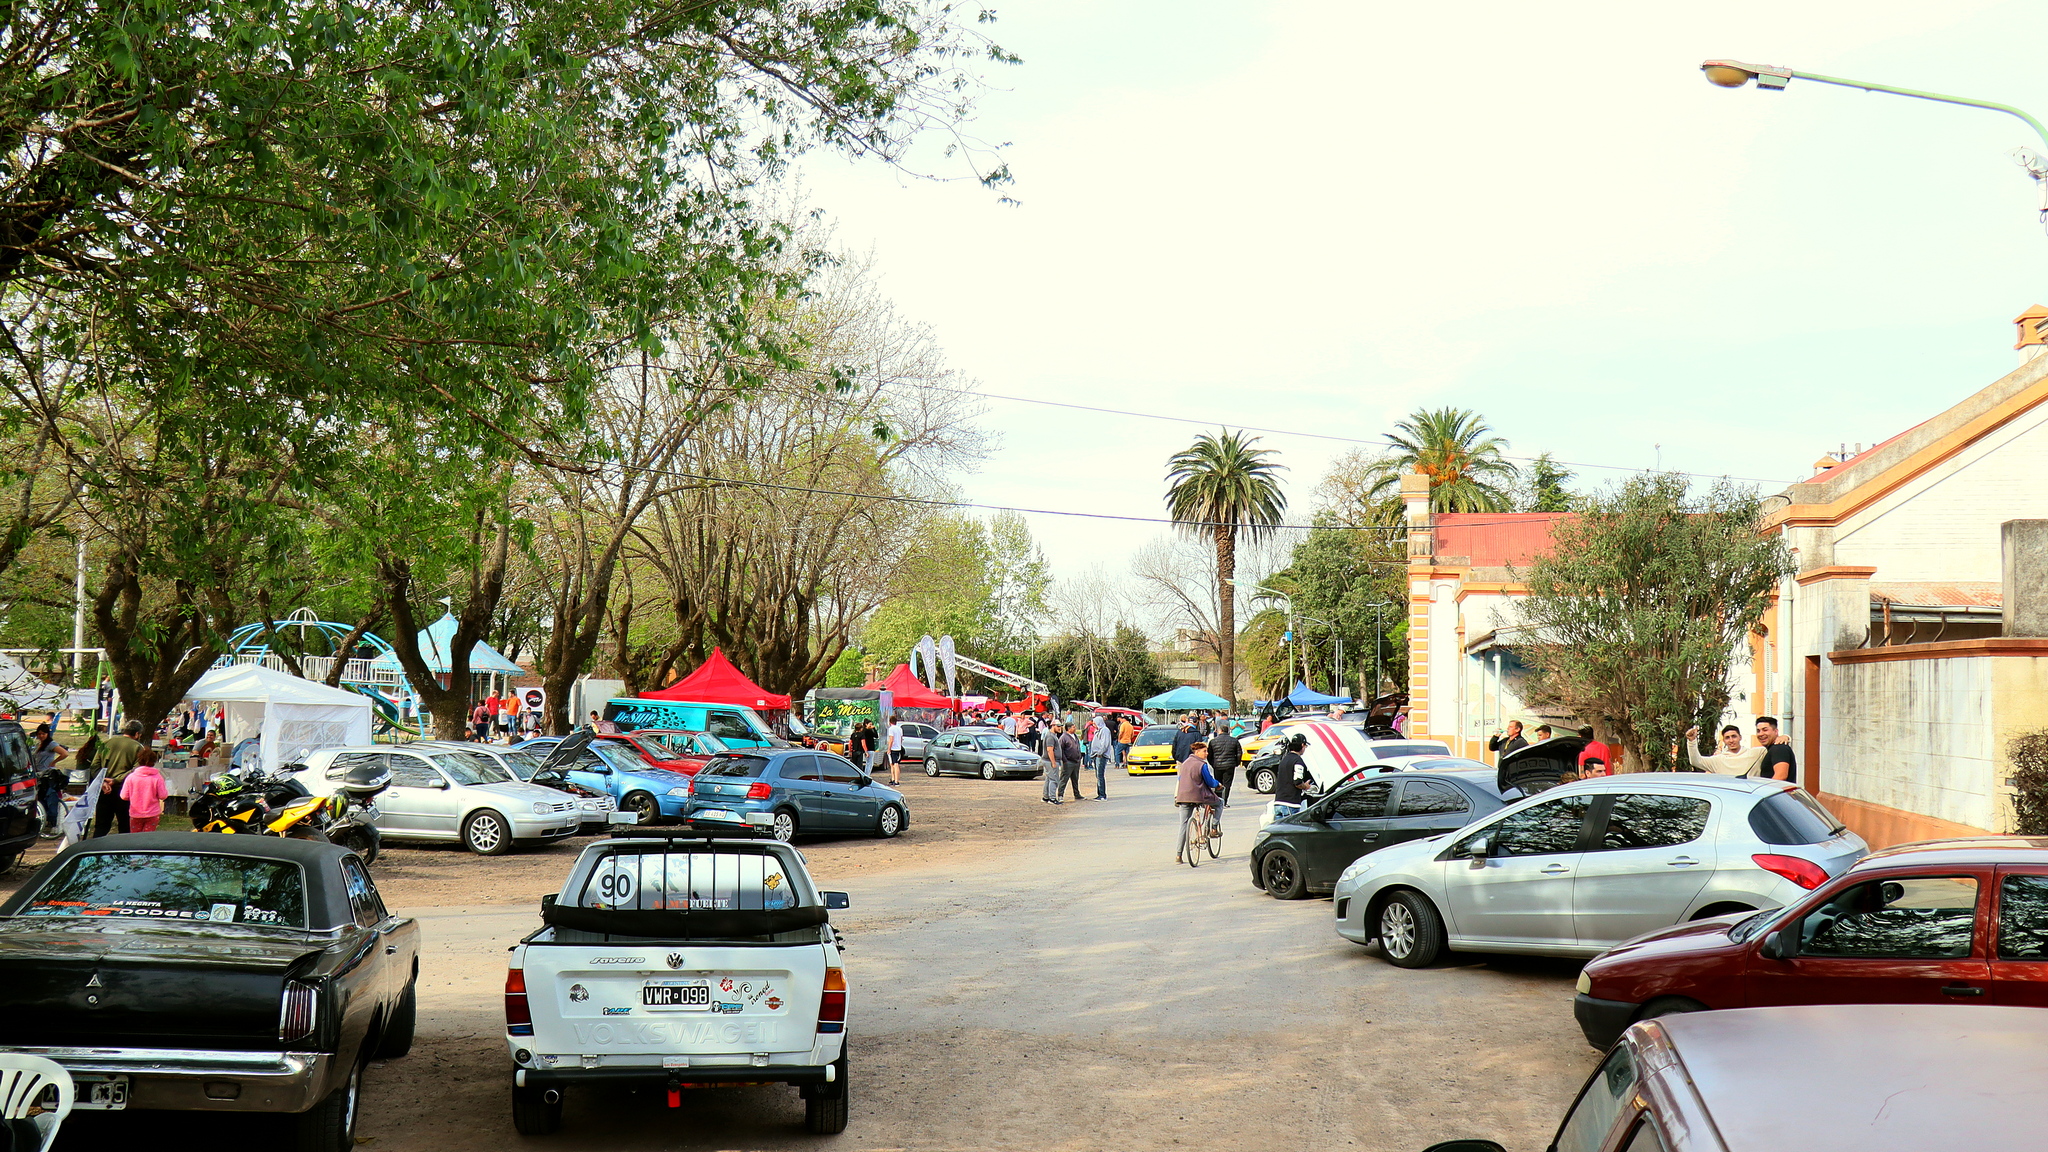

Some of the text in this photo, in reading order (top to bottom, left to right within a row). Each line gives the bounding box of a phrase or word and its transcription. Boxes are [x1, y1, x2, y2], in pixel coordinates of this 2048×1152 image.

[819, 704, 873, 717] La Mirta
[601, 874, 631, 898] 90
[119, 908, 193, 918] DODGE
[645, 987, 672, 1004] VWR
[681, 987, 708, 1004] 098
[573, 1021, 779, 1045] VOLKSWAGEN
